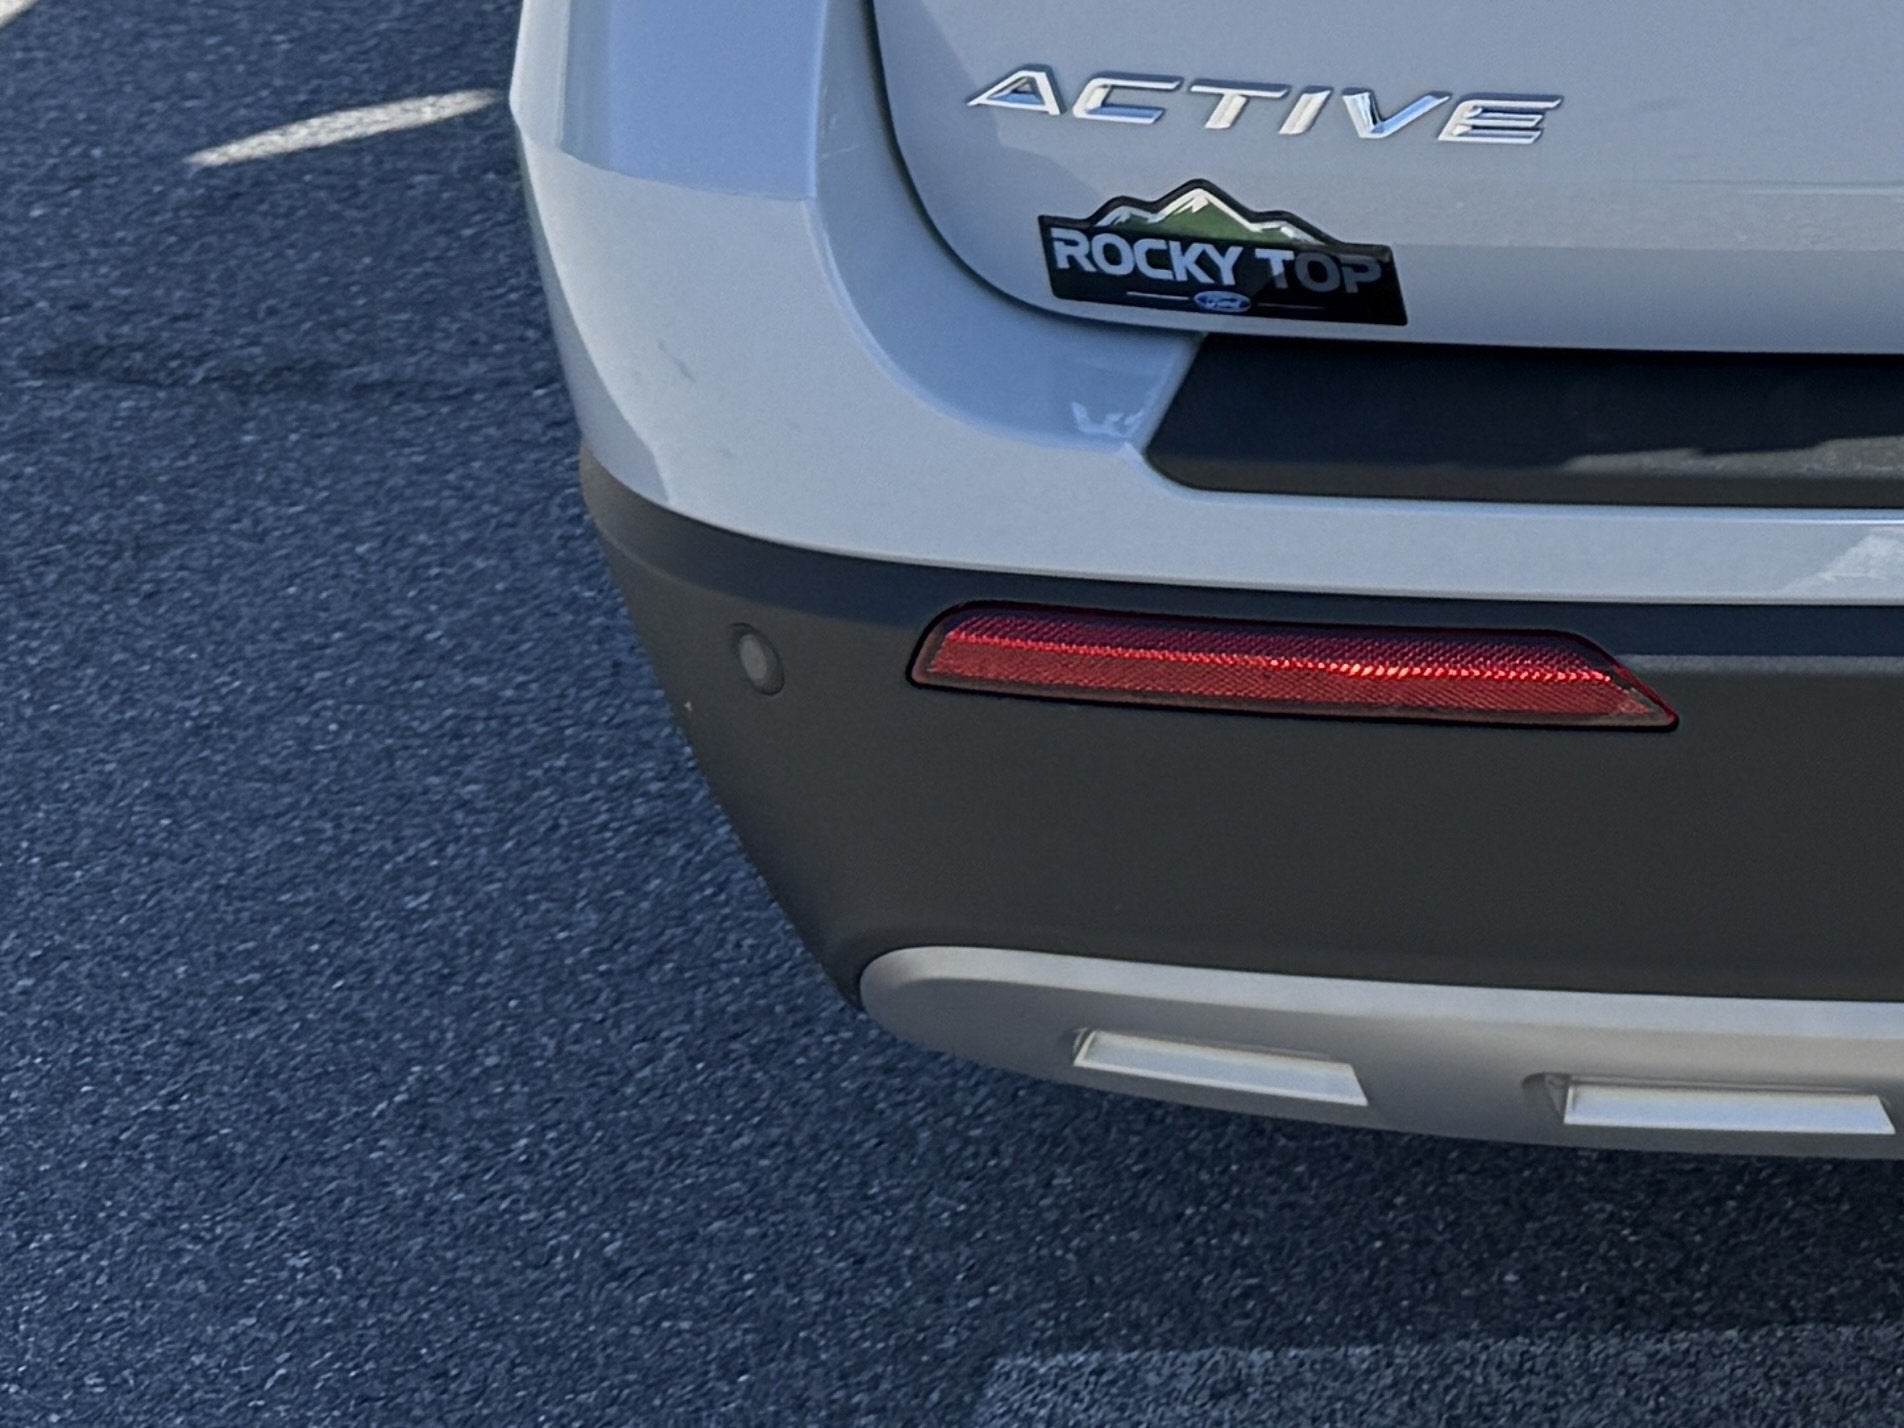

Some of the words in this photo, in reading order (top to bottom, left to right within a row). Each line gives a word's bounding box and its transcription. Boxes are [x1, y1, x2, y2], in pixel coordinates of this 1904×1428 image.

[965, 63, 1564, 144] ACTIVE
[1050, 227, 1244, 286] ROCKY
[1254, 248, 1383, 293] TOP
